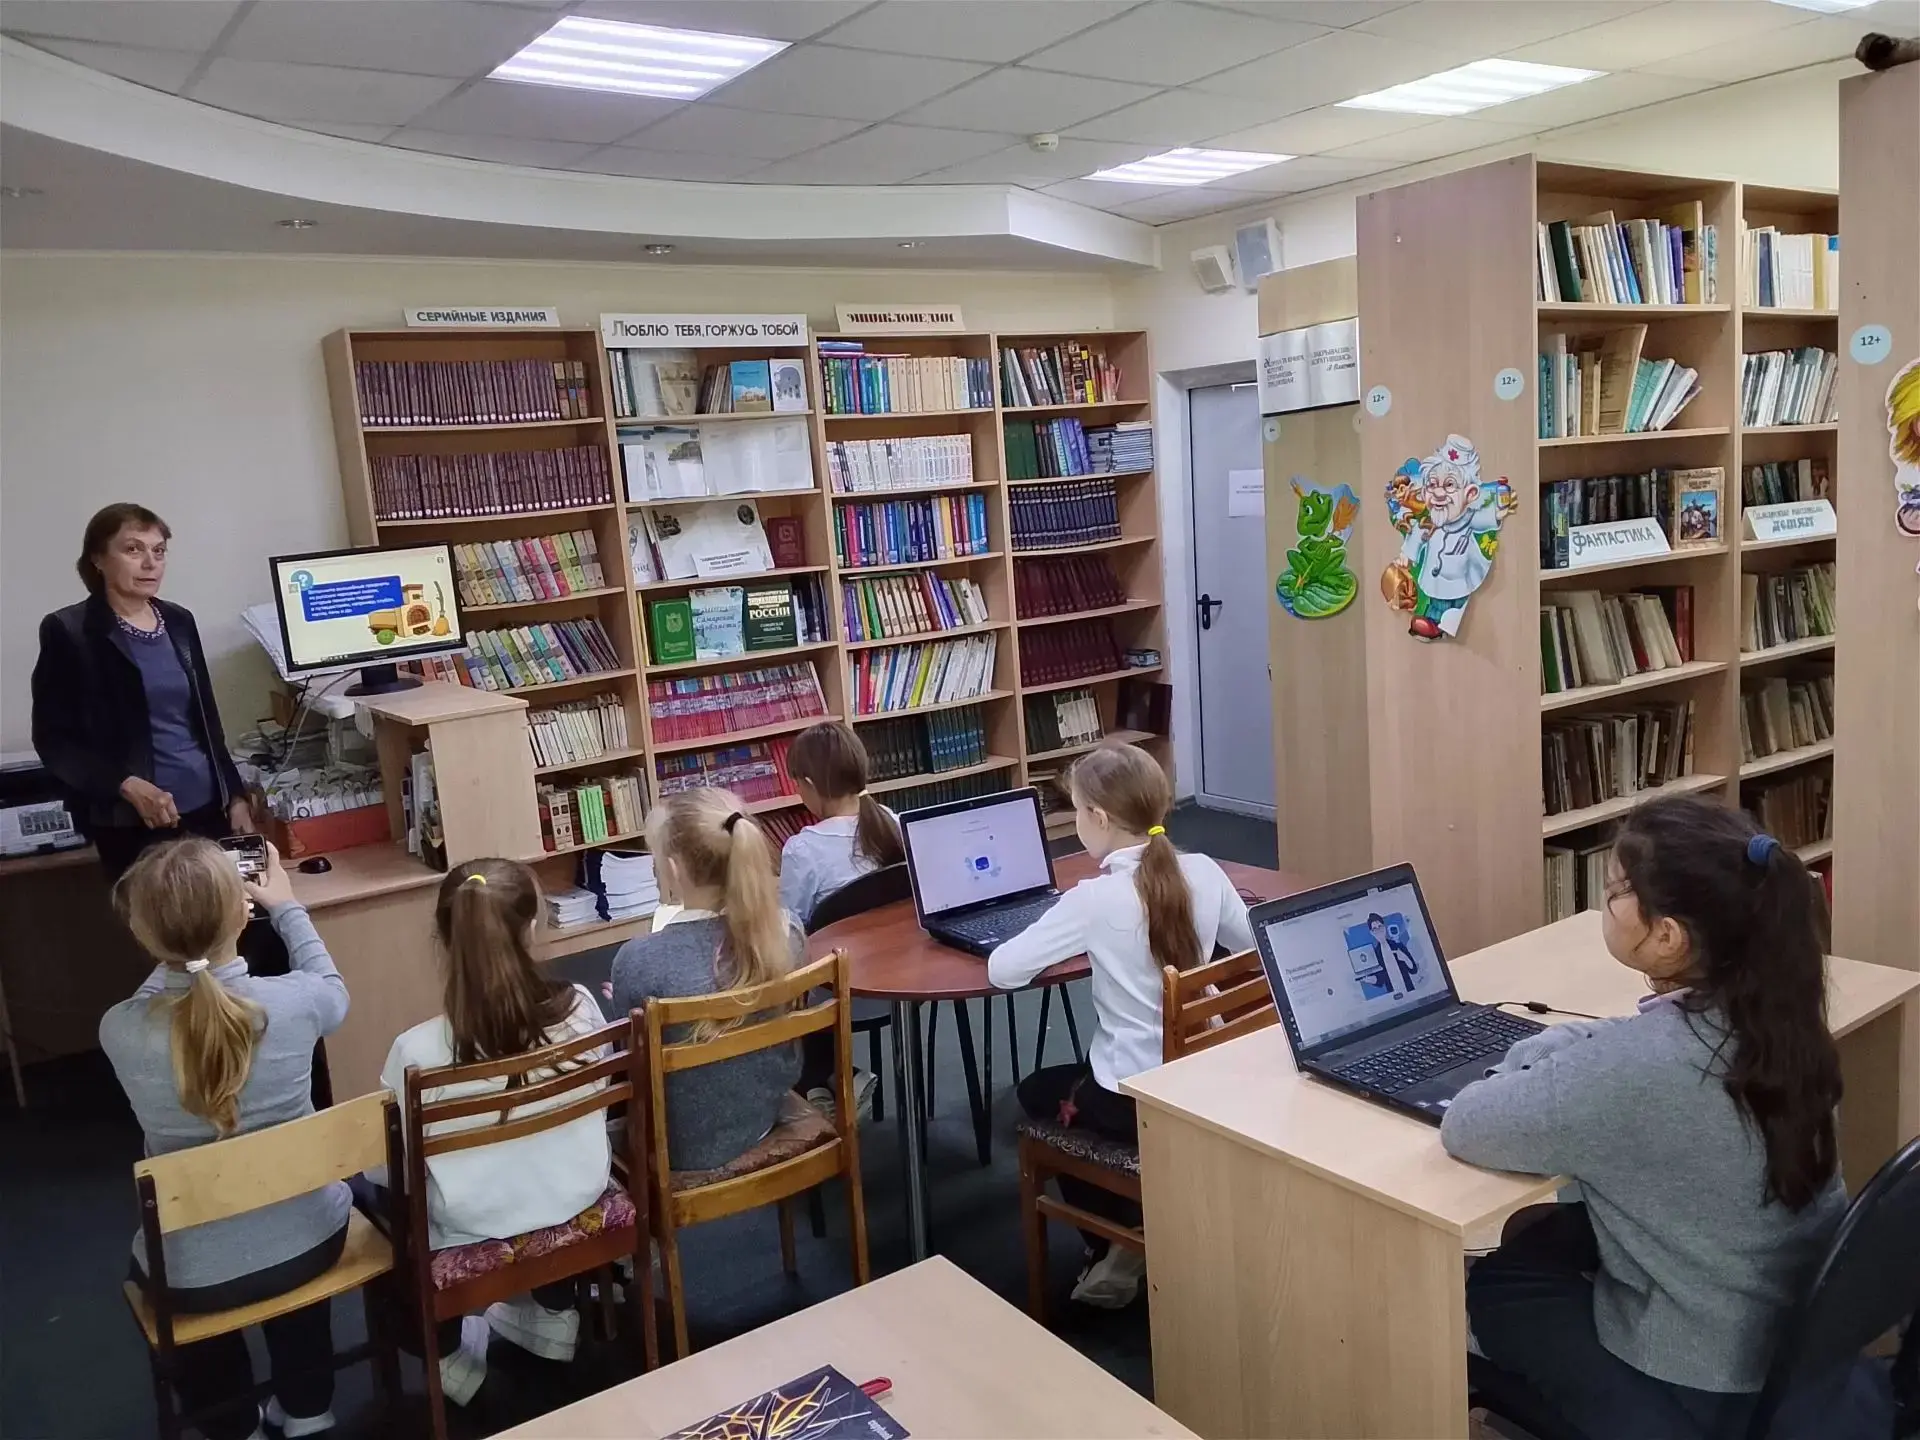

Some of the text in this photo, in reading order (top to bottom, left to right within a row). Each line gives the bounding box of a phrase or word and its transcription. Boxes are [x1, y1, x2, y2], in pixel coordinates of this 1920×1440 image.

[416, 309, 548, 324] СЕРИЙНЫЕ ИЗДАНИЯ
[846, 312, 955, 324] ЭНЦИКЛОПЕДИИ
[611, 320, 669, 337] ЛЮБЛЮ
[761, 321, 799, 336] ТОБОЙ
[1860, 335, 1881, 346] 12+
[1502, 376, 1516, 386] 12+
[1373, 394, 1385, 403] 12+
[1572, 526, 1656, 556] ФАНТАСТИКА
[749, 606, 791, 619] РОССИИ
